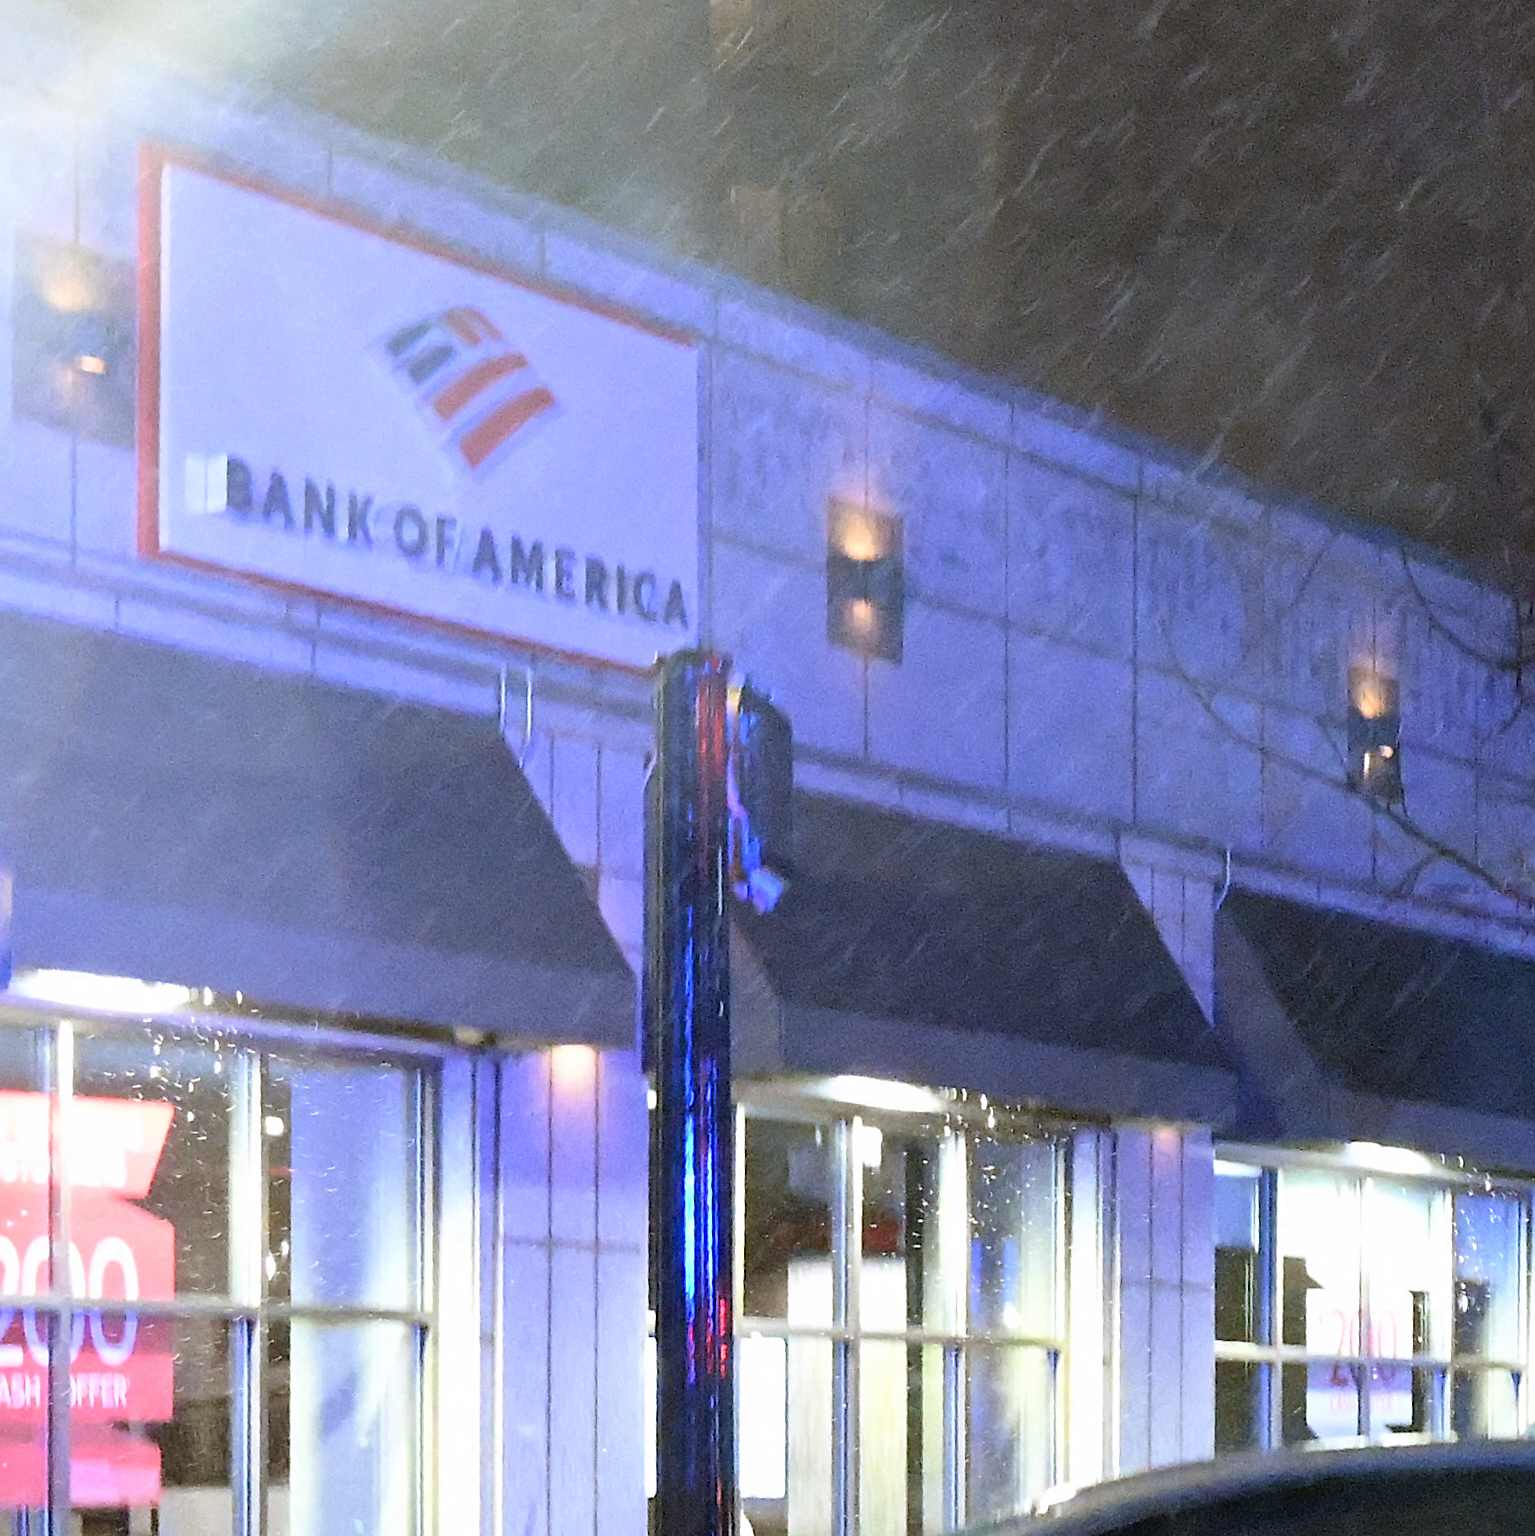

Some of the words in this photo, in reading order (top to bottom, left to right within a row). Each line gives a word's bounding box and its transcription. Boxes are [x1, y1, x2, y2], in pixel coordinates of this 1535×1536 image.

[226, 454, 375, 549] BANK
[394, 506, 457, 568] OF
[472, 526, 689, 629] AMERICA
